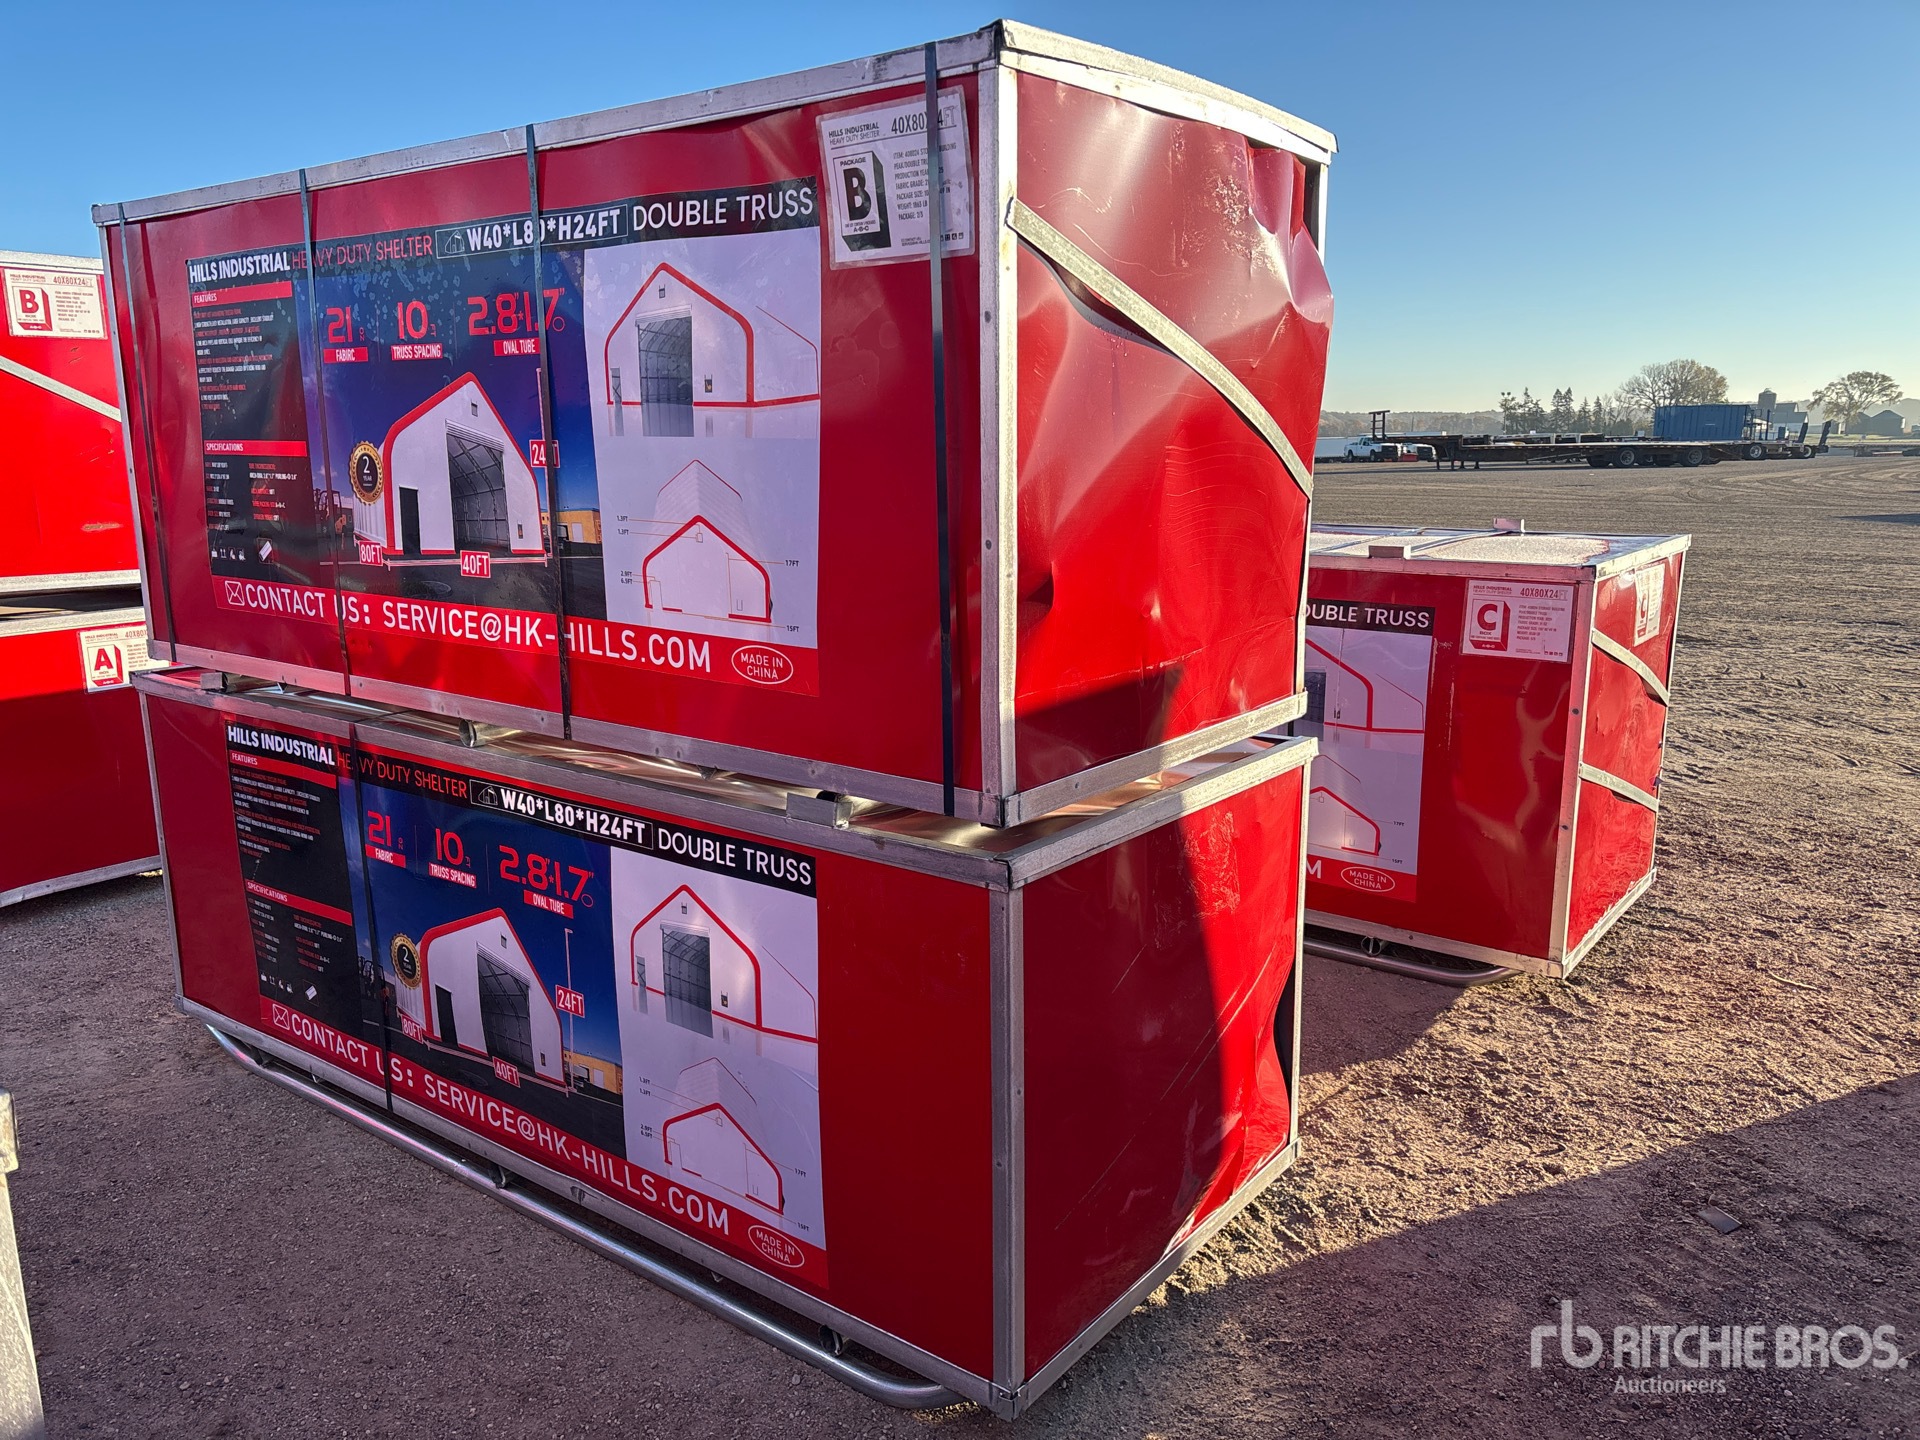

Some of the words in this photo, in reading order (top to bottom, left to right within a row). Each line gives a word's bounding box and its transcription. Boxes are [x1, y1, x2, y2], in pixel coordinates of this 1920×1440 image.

[828, 130, 843, 138] HILLS
[845, 122, 879, 134] INDUSTRIAL
[829, 136, 845, 145] HEAVY
[845, 134, 859, 143] DUTY
[840, 157, 866, 167] PACKAGE
[843, 167, 872, 221] B
[189, 261, 218, 283] HILLS
[219, 251, 290, 279] INDUSTRIAL
[337, 242, 372, 265] DUTY
[376, 235, 433, 261] SHELTER
[633, 197, 727, 231] DOUBLE
[735, 187, 814, 222] TRUSS
[19, 289, 39, 313] B
[194, 293, 217, 303] FEATURES
[326, 306, 353, 343] 21
[397, 300, 428, 340] 10
[392, 345, 413, 359] TRUSS
[413, 344, 441, 359] SPACING
[503, 340, 519, 354] OVAL
[519, 339, 536, 353] TUBE
[206, 443, 244, 452] SPECIFICATIONS
[532, 443, 557, 465] 24T
[362, 455, 370, 473] 2
[360, 543, 382, 564] 80FT
[785, 559, 799, 567] 17FT
[462, 554, 489, 576] 40FT
[245, 583, 325, 618] CONTACT
[383, 601, 711, 673] SERVICE@HK-HILLS.COM
[1364, 607, 1429, 628] TRUSS
[1477, 603, 1498, 631] C
[786, 625, 799, 633] 15FT
[94, 648, 114, 671] A
[740, 652, 770, 667] MADE
[772, 657, 783, 668] IN
[746, 665, 779, 680] CHINA
[231, 753, 258, 766] FEATURES
[228, 725, 259, 748] HILLS
[261, 732, 335, 766] INDUSTRIAL
[337, 751, 374, 775] HEVY
[377, 761, 410, 784] DUTY
[414, 769, 467, 799] SHELTER
[658, 827, 736, 868] DOUBLE
[742, 847, 812, 886] TRUSS
[367, 810, 392, 847] 21
[435, 828, 463, 865] 10
[430, 863, 449, 880] TRUSS
[450, 869, 475, 887] SPACING
[1349, 870, 1376, 881] MADE
[1354, 878, 1382, 889] CHINA
[247, 882, 288, 902] SPECIFICATIONS
[533, 893, 548, 910] OVAL
[549, 898, 565, 915] TUBE
[402, 946, 410, 962] 2
[557, 989, 583, 1016] 24FT
[403, 1018, 422, 1042] 80FT
[494, 1060, 518, 1084] 40FT
[292, 1013, 368, 1067] CONTACT
[424, 1074, 729, 1235] SERVICE@HK-HILLS.COM
[756, 1229, 781, 1249] MADE
[784, 1243, 795, 1256] IN
[761, 1242, 790, 1264] CHINA
